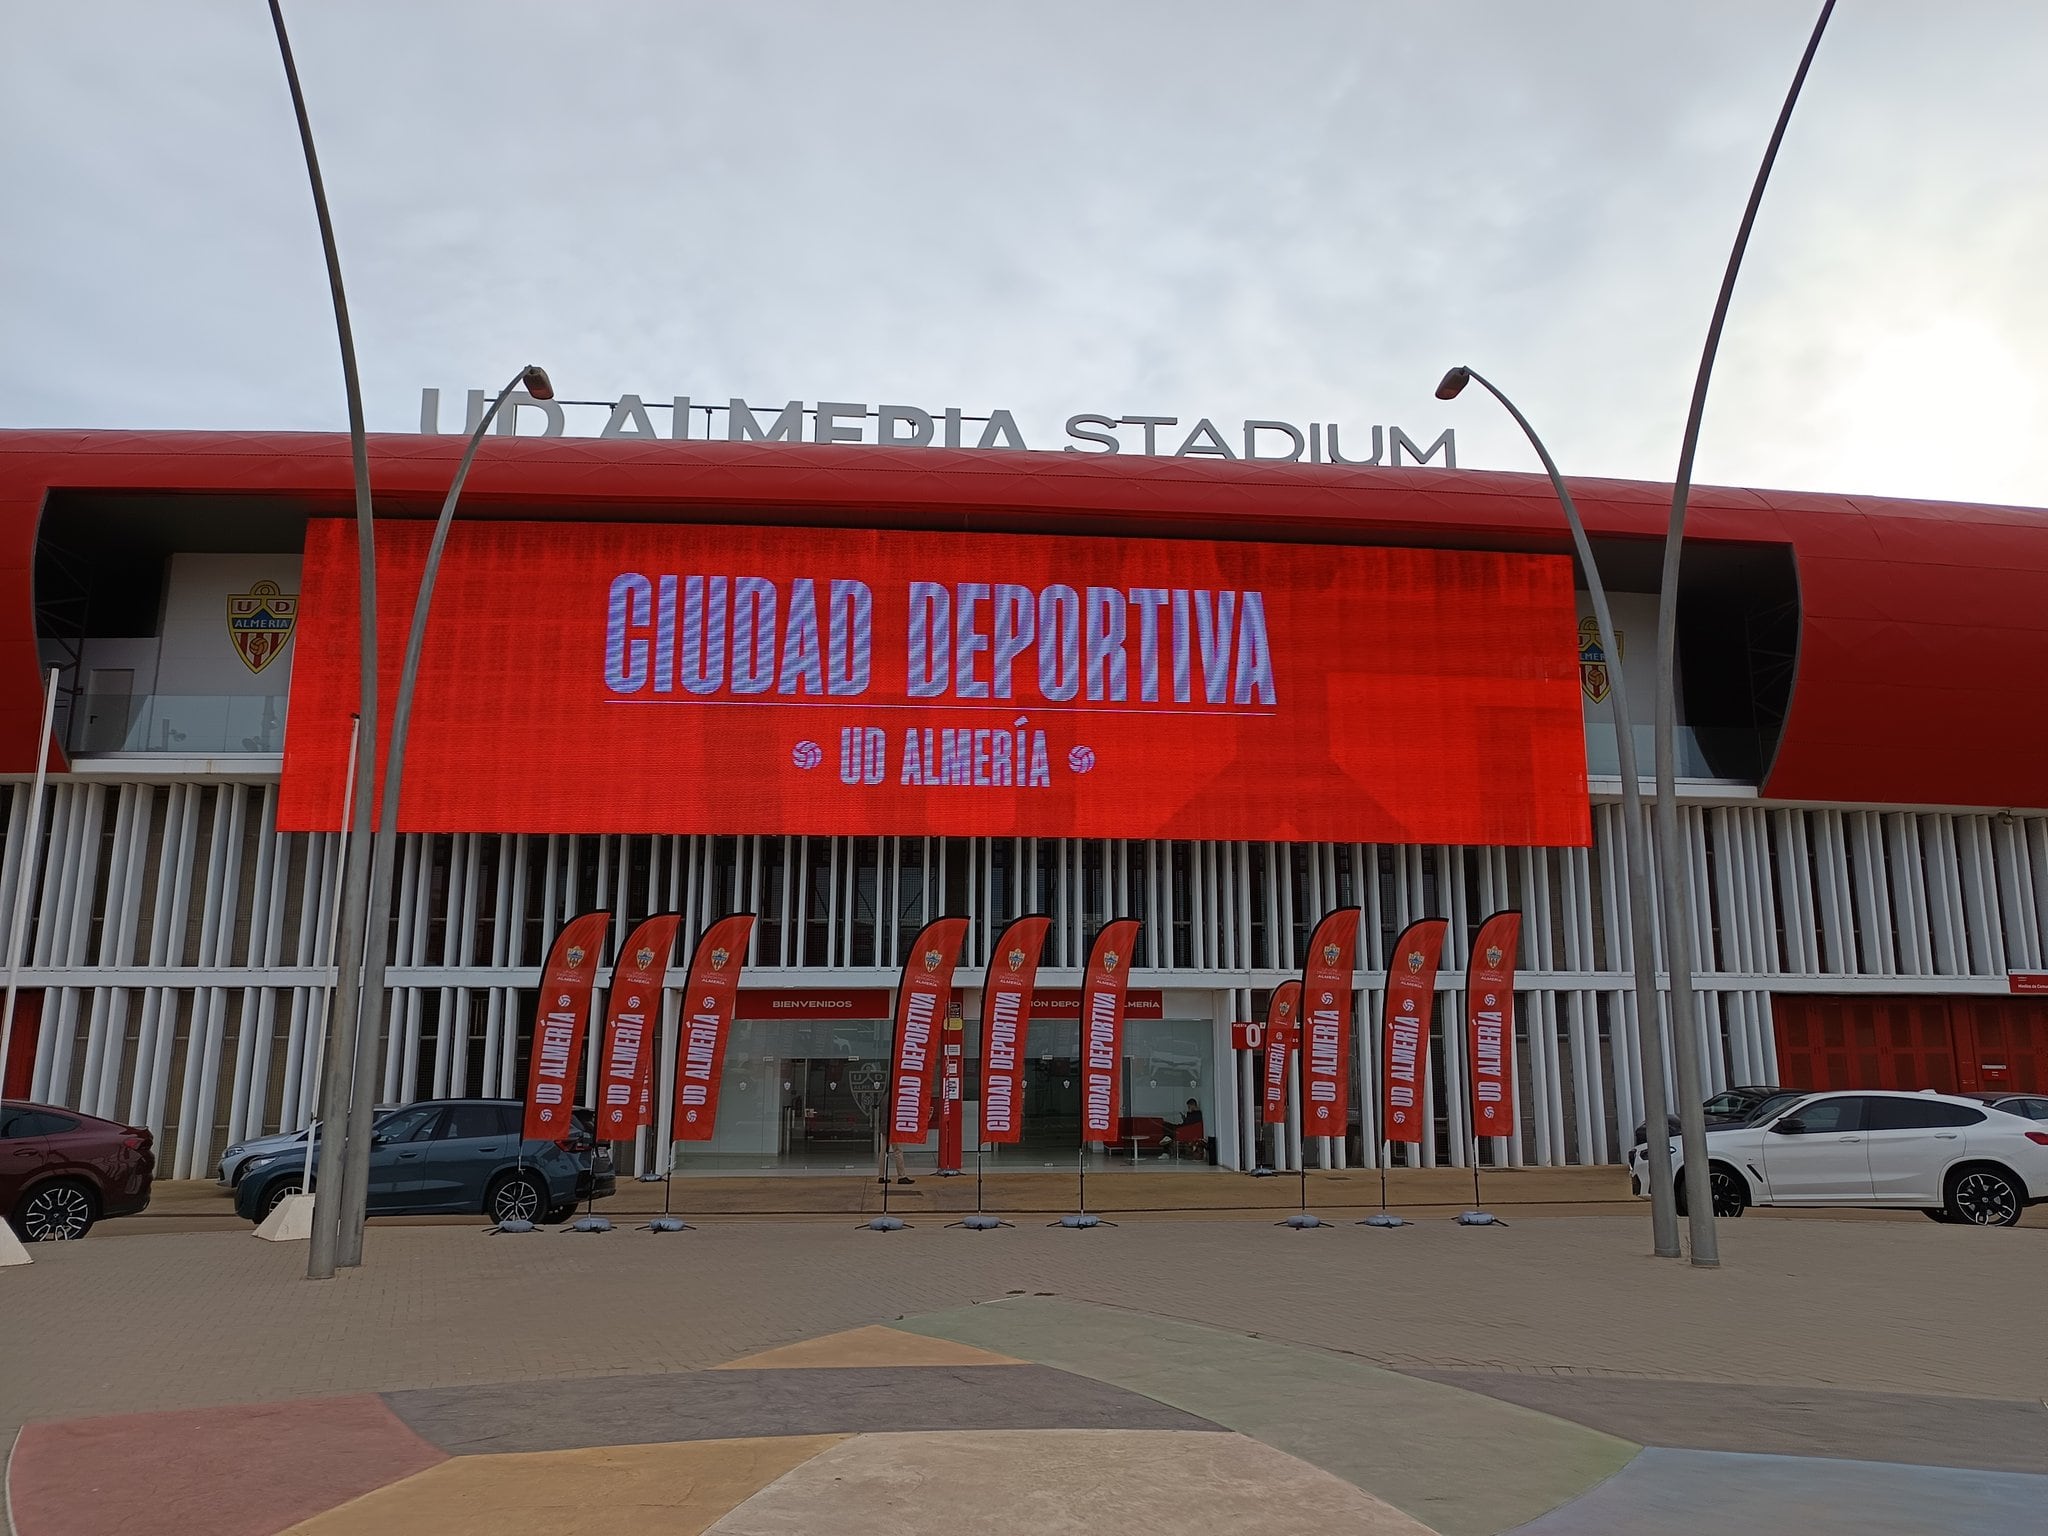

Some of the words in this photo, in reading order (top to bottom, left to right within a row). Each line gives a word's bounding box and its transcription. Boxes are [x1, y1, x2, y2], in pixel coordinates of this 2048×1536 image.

[1064, 414, 1456, 469] STADIUM
[234, 619, 288, 628] ALMERIA
[237, 601, 251, 611] U
[275, 601, 290, 612] D
[604, 572, 872, 696] CIUDAD
[907, 581, 1277, 705] DEPORTIVA
[840, 726, 886, 784] UD
[901, 716, 1050, 787] ALMERÍA
[772, 1000, 853, 1008] BIENVENIDOS
[901, 992, 937, 1072] DEPORTIVA
[990, 992, 1022, 1070] DEPORTIVA
[1089, 992, 1117, 1070] DEPORTIVA
[539, 1012, 576, 1079] ALMERÍA
[610, 1013, 645, 1080] ALMERÍA
[685, 1014, 720, 1081] ALMERÍA
[1246, 1023, 1261, 1048] 0
[1267, 1043, 1286, 1085] ALMERÍA
[1307, 1010, 1340, 1077] ALMERÍA
[1388, 1016, 1420, 1082] ALMERÍA
[1472, 1011, 1503, 1077] ALMERÍA
[536, 1083, 563, 1105] UD
[606, 1084, 631, 1105] UD
[682, 1084, 707, 1106] UD
[895, 1075, 922, 1133] CIUDAD
[987, 1075, 1013, 1132] CIUDAD
[1089, 1073, 1112, 1131] CIUDAD
[1268, 1088, 1280, 1100] UD
[1311, 1081, 1337, 1102] UD
[1391, 1086, 1414, 1107] UD
[1478, 1082, 1502, 1102] UD
